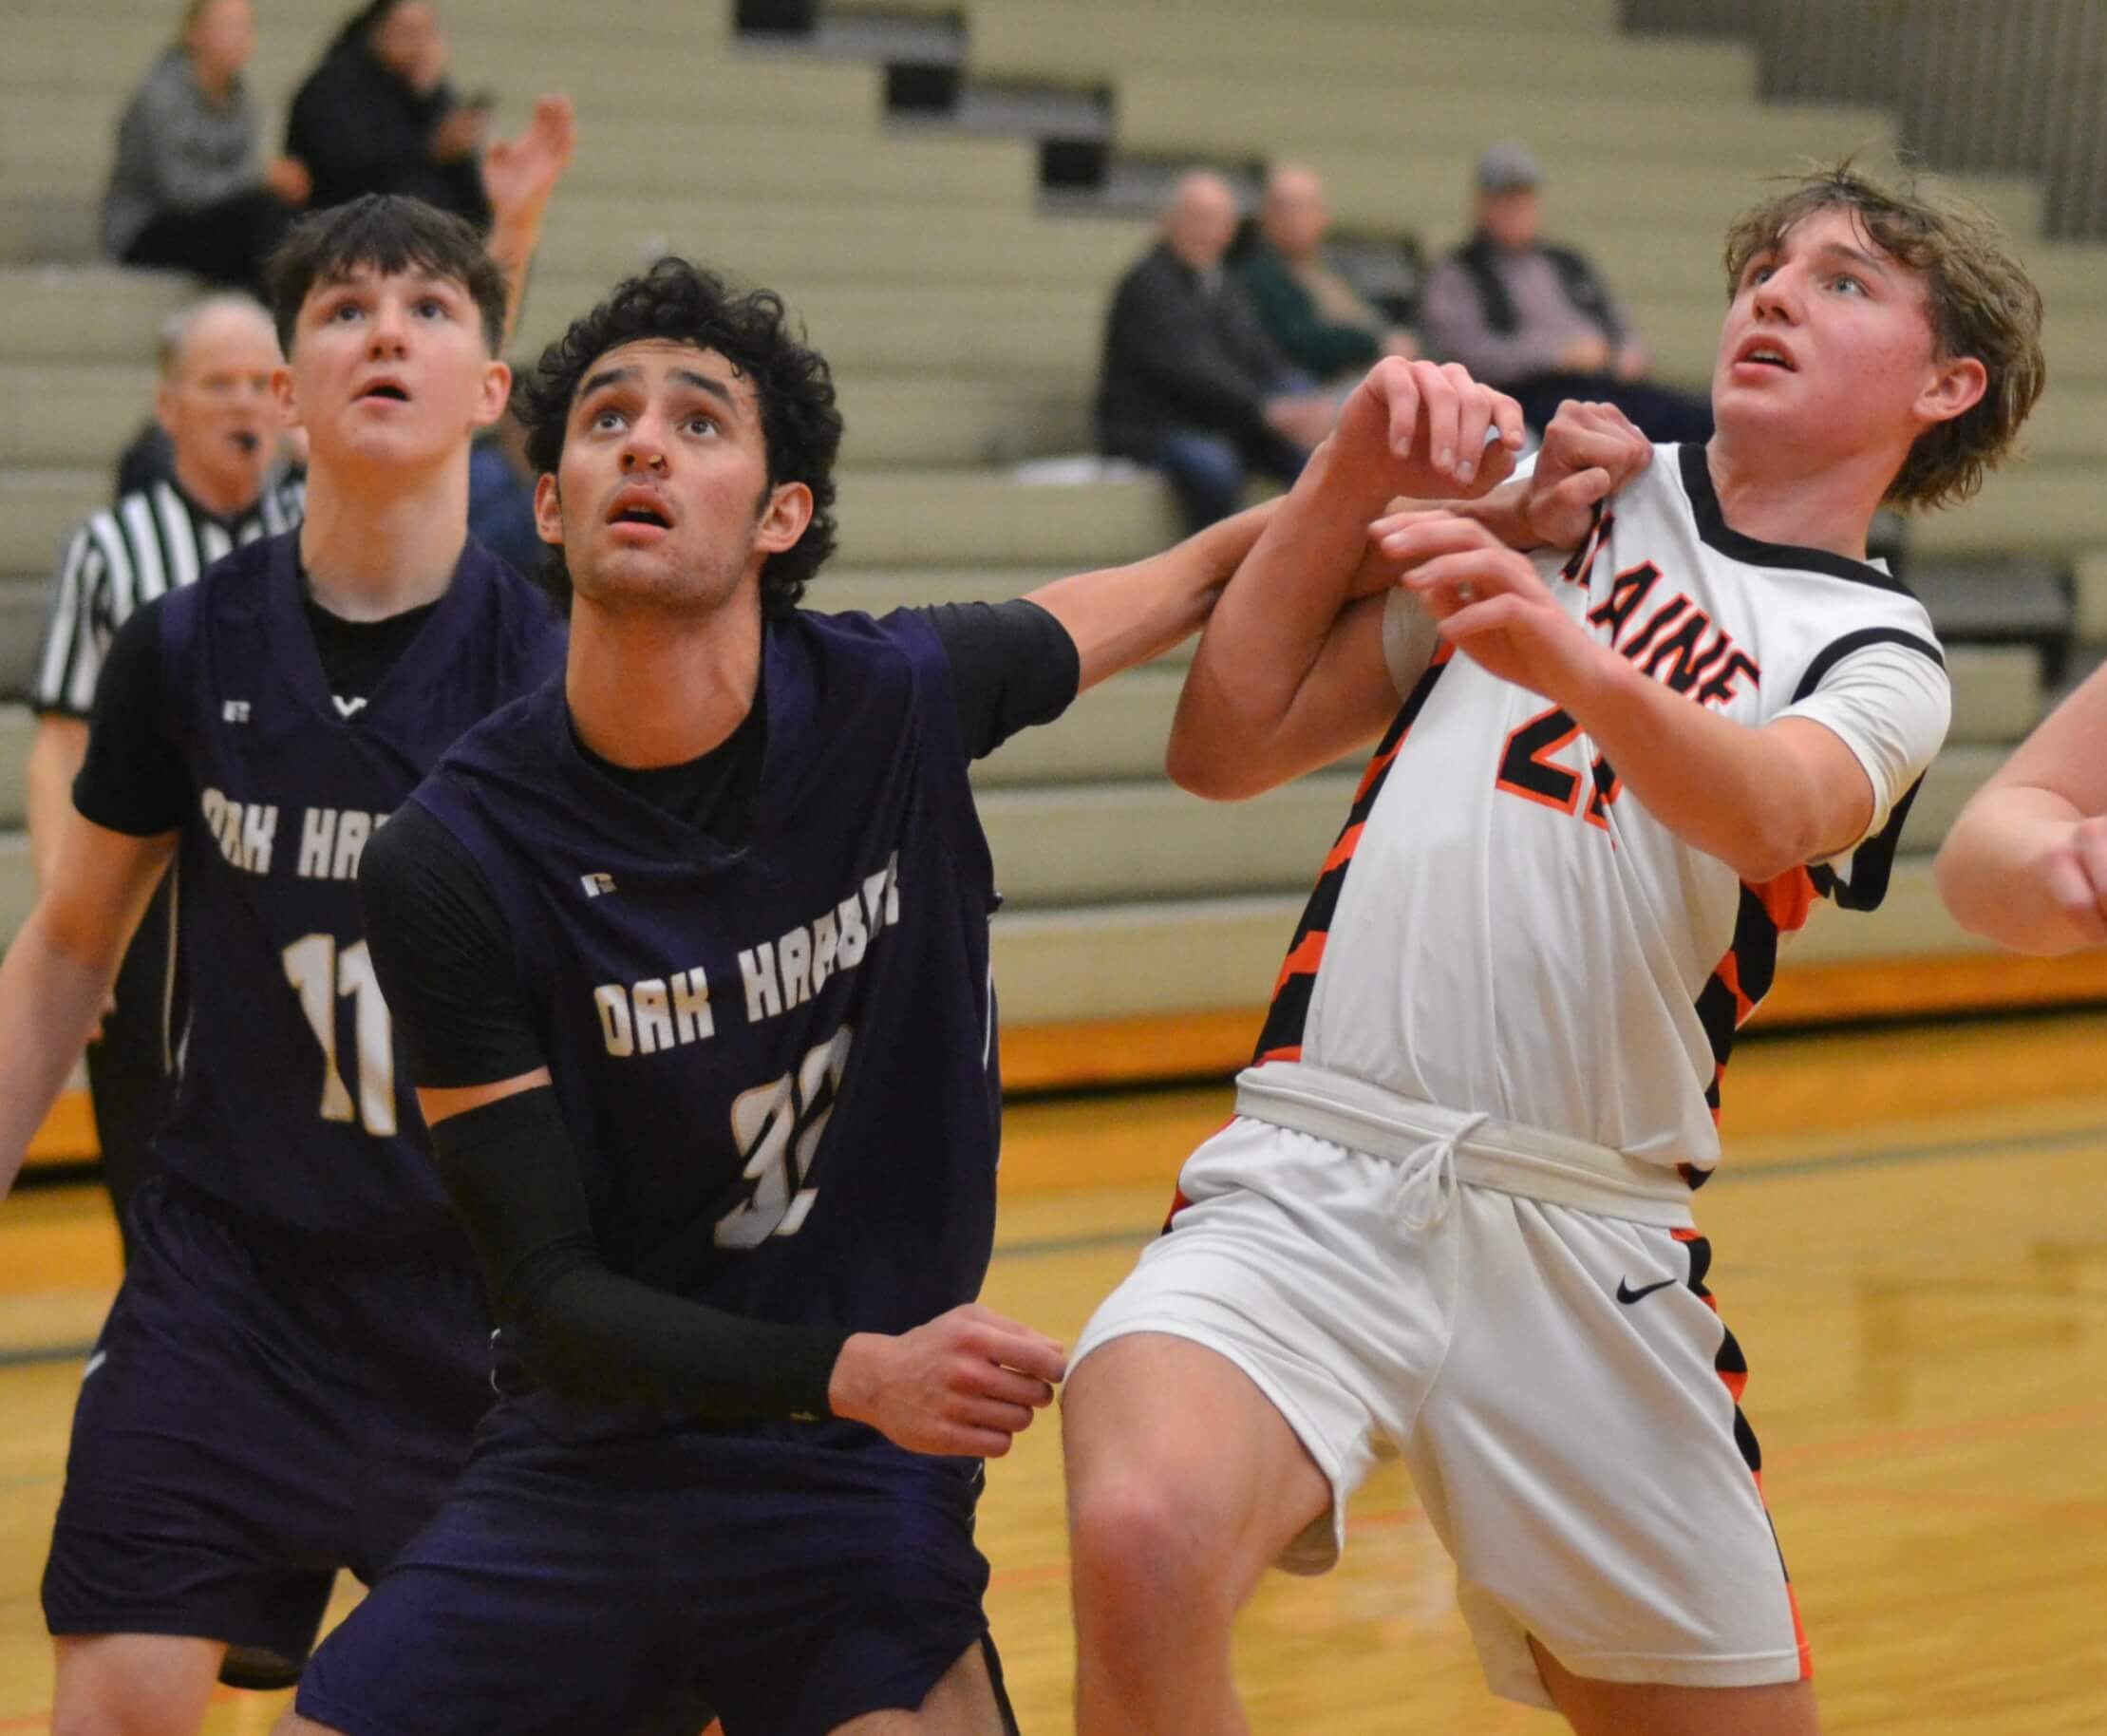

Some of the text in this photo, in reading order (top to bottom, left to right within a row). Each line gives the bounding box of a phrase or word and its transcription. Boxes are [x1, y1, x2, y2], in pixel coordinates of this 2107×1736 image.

[282, 933, 397, 1137] 11
[593, 966, 715, 1057] OAK
[713, 1023, 854, 1250] 32
